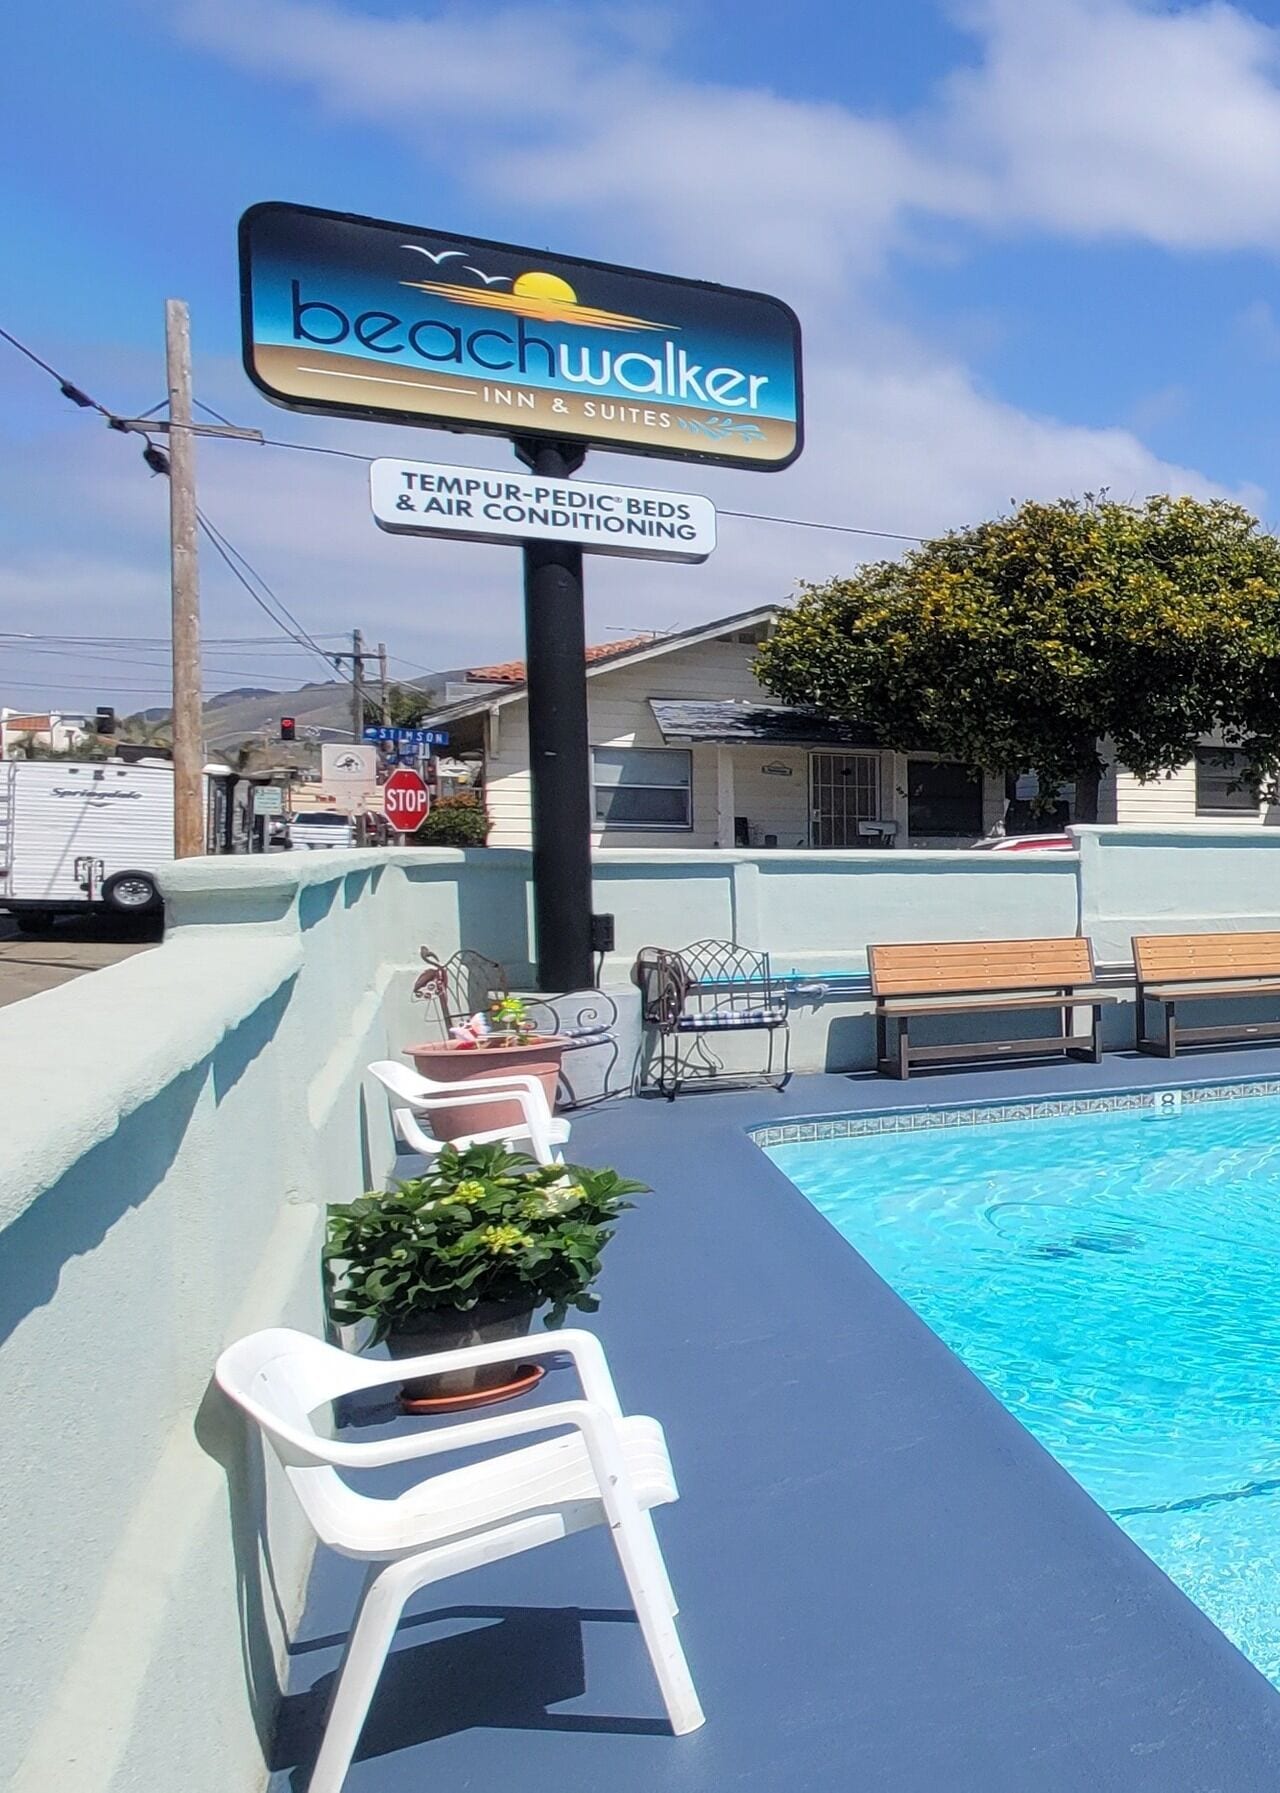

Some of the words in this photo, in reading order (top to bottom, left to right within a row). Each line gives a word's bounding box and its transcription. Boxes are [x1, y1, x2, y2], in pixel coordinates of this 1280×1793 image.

[290, 278, 770, 411] beachwalker
[484, 386, 535, 409] INN
[551, 397, 569, 414] &
[583, 401, 671, 428] SUITES
[396, 494, 417, 512] &
[424, 497, 474, 518] AIR
[482, 503, 697, 541] CONDITIONING
[627, 498, 691, 520] BEDS
[379, 731, 443, 743] STIMSON
[50, 787, 143, 800] Springdale
[386, 788, 427, 813] STOP
